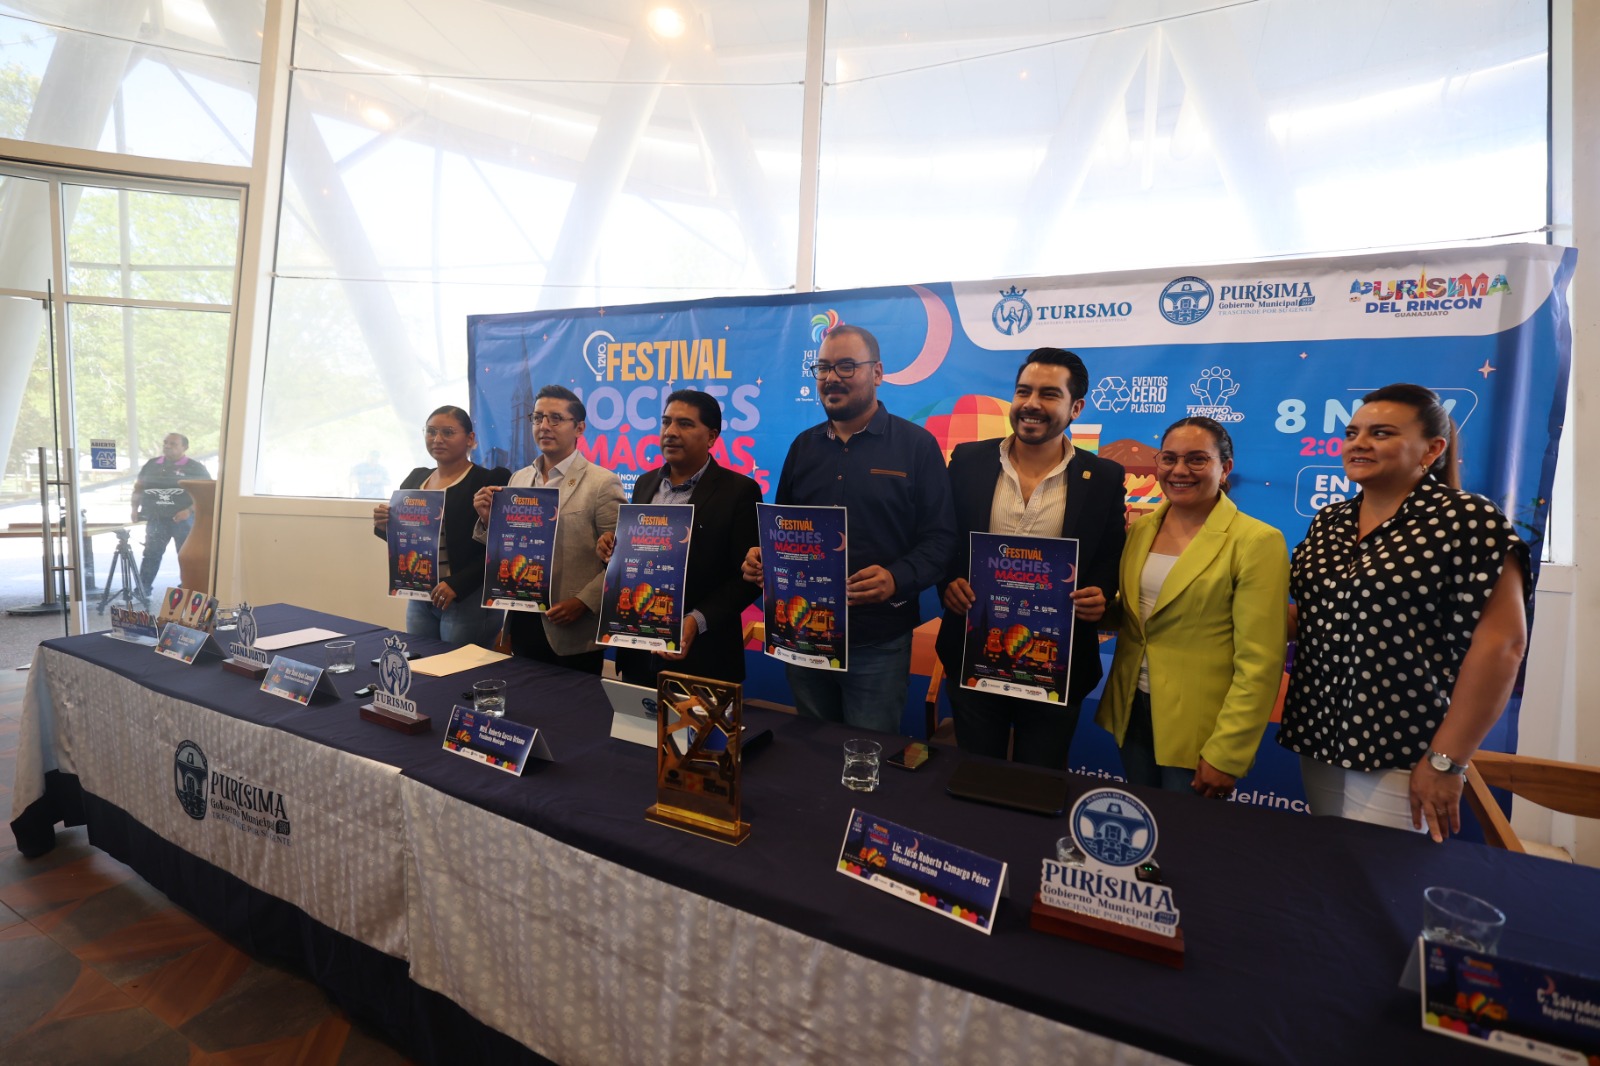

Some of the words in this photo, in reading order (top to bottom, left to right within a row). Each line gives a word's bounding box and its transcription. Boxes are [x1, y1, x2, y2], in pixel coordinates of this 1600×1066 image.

[1219, 281, 1312, 302] PURÍSIMA
[1036, 301, 1133, 320] TURISMO
[1218, 301, 1254, 309] Gobierno
[1258, 299, 1299, 309] Municipal
[1365, 302, 1401, 313] DEL
[1406, 297, 1483, 312] RINCÓN
[606, 338, 732, 381] FESTIVAL
[1132, 376, 1168, 387] EVENTOS
[1131, 386, 1167, 403] CERO
[573, 384, 761, 432] OCS
[1130, 402, 1166, 413] PLÁSTICO
[1186, 406, 1229, 415] TURISMO
[1274, 398, 1306, 434] 8
[577, 423, 756, 476] MÁGAS
[395, 505, 430, 515] NOCHES
[502, 505, 543, 515] NOCHES
[506, 513, 542, 523] MÁGICAS
[642, 515, 668, 526] FESTIVAL
[781, 519, 813, 530] FESTIVAL
[628, 525, 672, 537] NOCHES
[769, 528, 821, 544] NOCHES
[631, 535, 671, 545] MÁGICAS
[774, 541, 821, 554] MÁGICAS
[1005, 547, 1043, 561] FESTIVAL
[988, 556, 1050, 573] NOCHES
[994, 568, 1049, 583] MÁGICAS
[375, 691, 415, 713] TURISMO
[211, 770, 288, 820] PURÍSIMA
[891, 854, 911, 867] Director
[911, 861, 918, 869] de
[918, 863, 938, 878] Turismo
[892, 842, 903, 855] Lic.
[904, 846, 918, 860] José
[918, 851, 942, 869] Roberto
[943, 860, 970, 881] Camargo
[971, 873, 991, 887] Pérez
[1044, 861, 1175, 913] PURÍSIMA
[1043, 883, 1093, 904] Gobierno
[1097, 897, 1154, 920] Municipal
[1043, 895, 1101, 916] TRASCIENDE
[1103, 911, 1123, 922] POR
[1126, 915, 1138, 925] SU
[1140, 919, 1174, 935] GENTE
